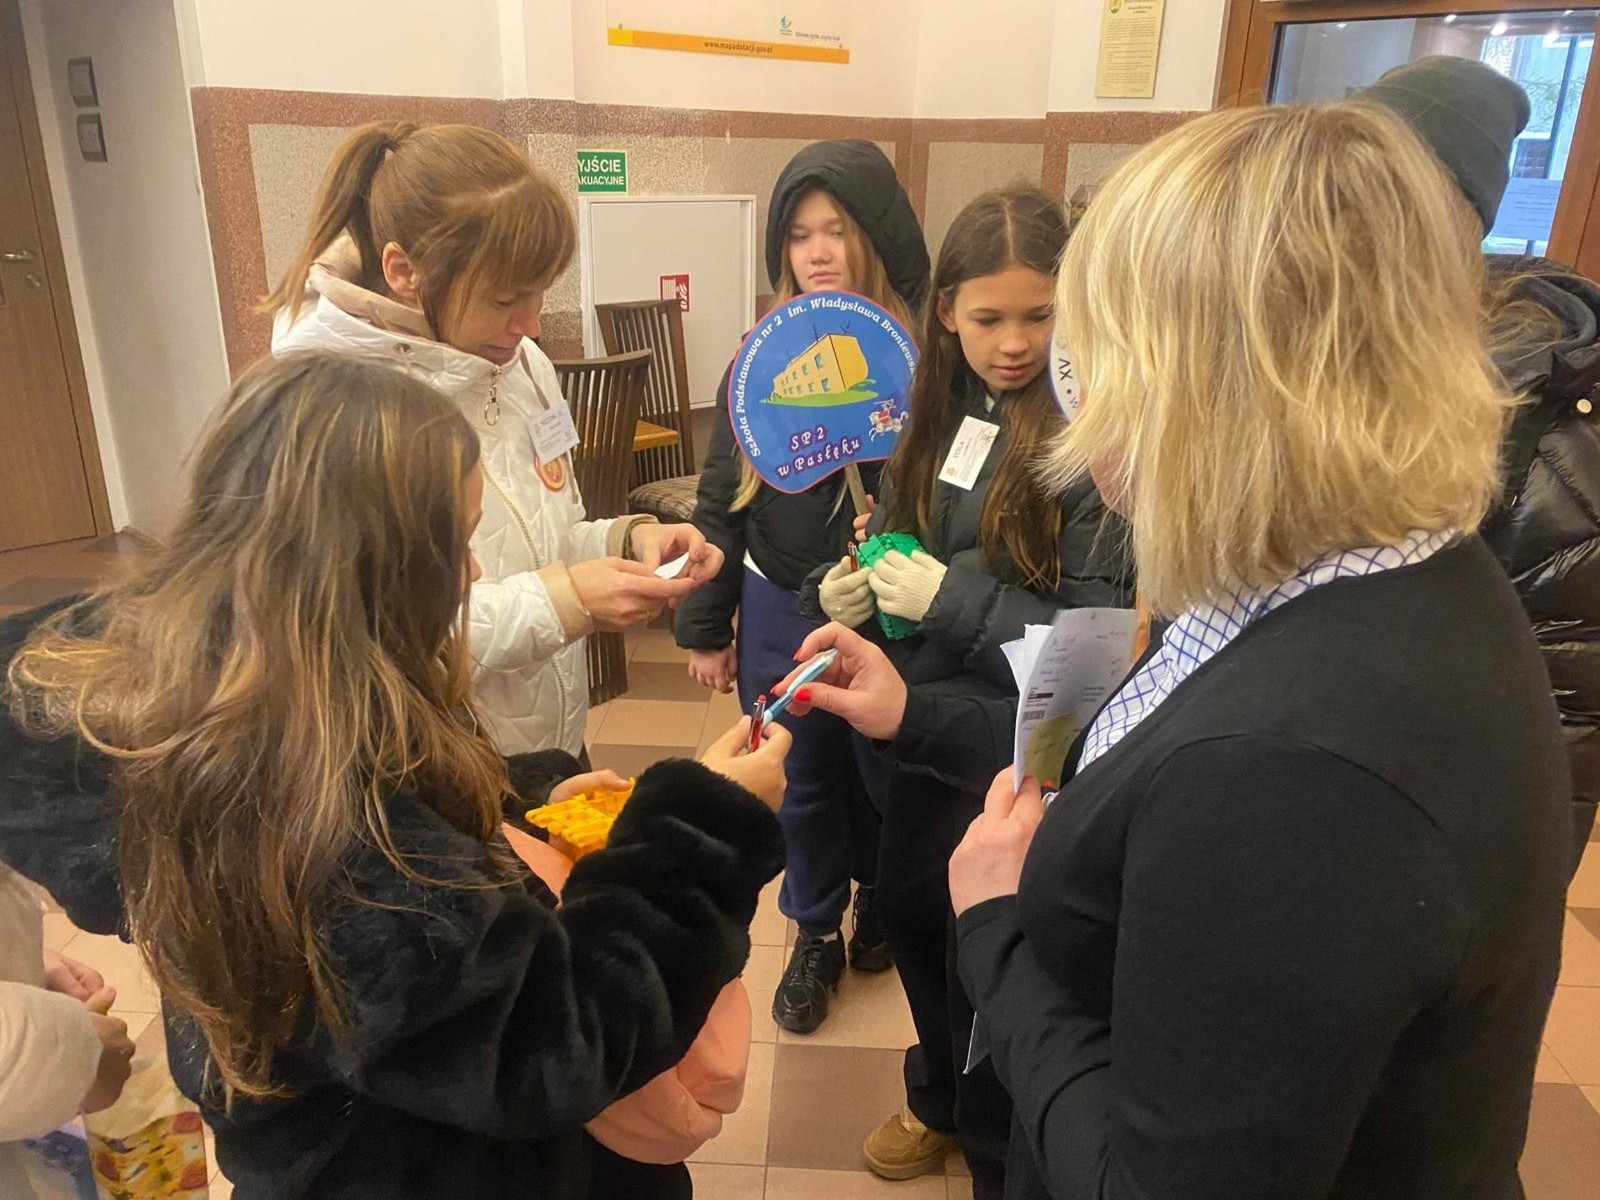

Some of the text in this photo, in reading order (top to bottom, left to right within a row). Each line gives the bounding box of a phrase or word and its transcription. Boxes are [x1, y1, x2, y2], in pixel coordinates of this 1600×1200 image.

[703, 40, 773, 53] www.mapadotacji.gov.pl
[577, 155, 622, 173] YJŚCIE
[774, 315, 784, 327] 2
[787, 306, 807, 319] im.
[810, 297, 881, 324] Władysława
[761, 323, 773, 339] nr
[736, 338, 763, 414] Podstawowa
[1058, 358, 1073, 381] XV
[739, 416, 761, 457] Szkoła
[791, 426, 825, 450] SP 2
[777, 438, 860, 477] w Pasłęku
